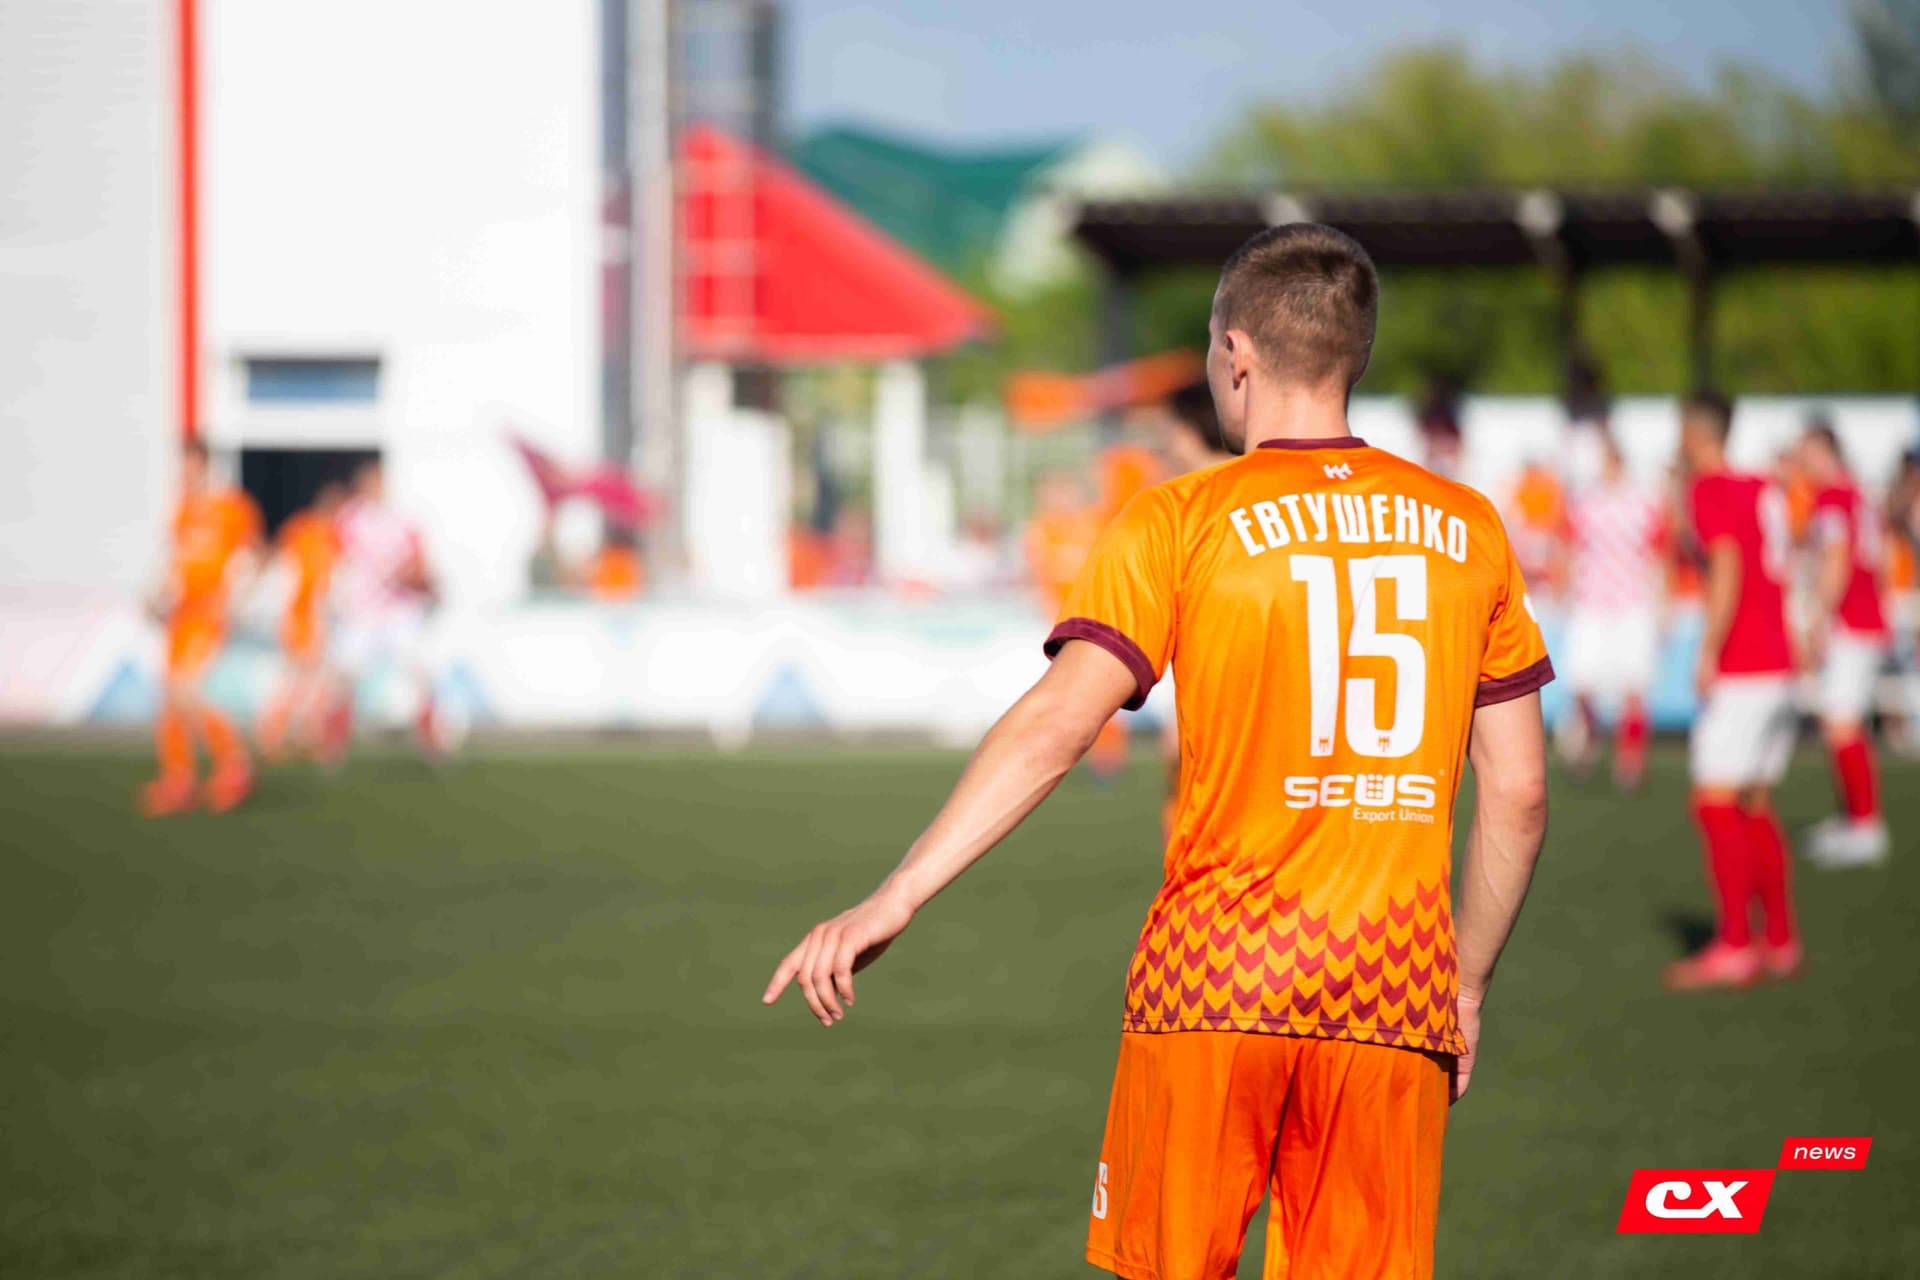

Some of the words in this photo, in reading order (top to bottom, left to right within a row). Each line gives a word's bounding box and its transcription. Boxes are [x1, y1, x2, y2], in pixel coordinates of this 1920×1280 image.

[1229, 493, 1467, 563] ЕВТУШЕНКО
[1289, 554, 1428, 758] 15
[1284, 773, 1436, 809] SEUS
[1353, 808, 1395, 823] Export
[1399, 808, 1434, 823] Union
